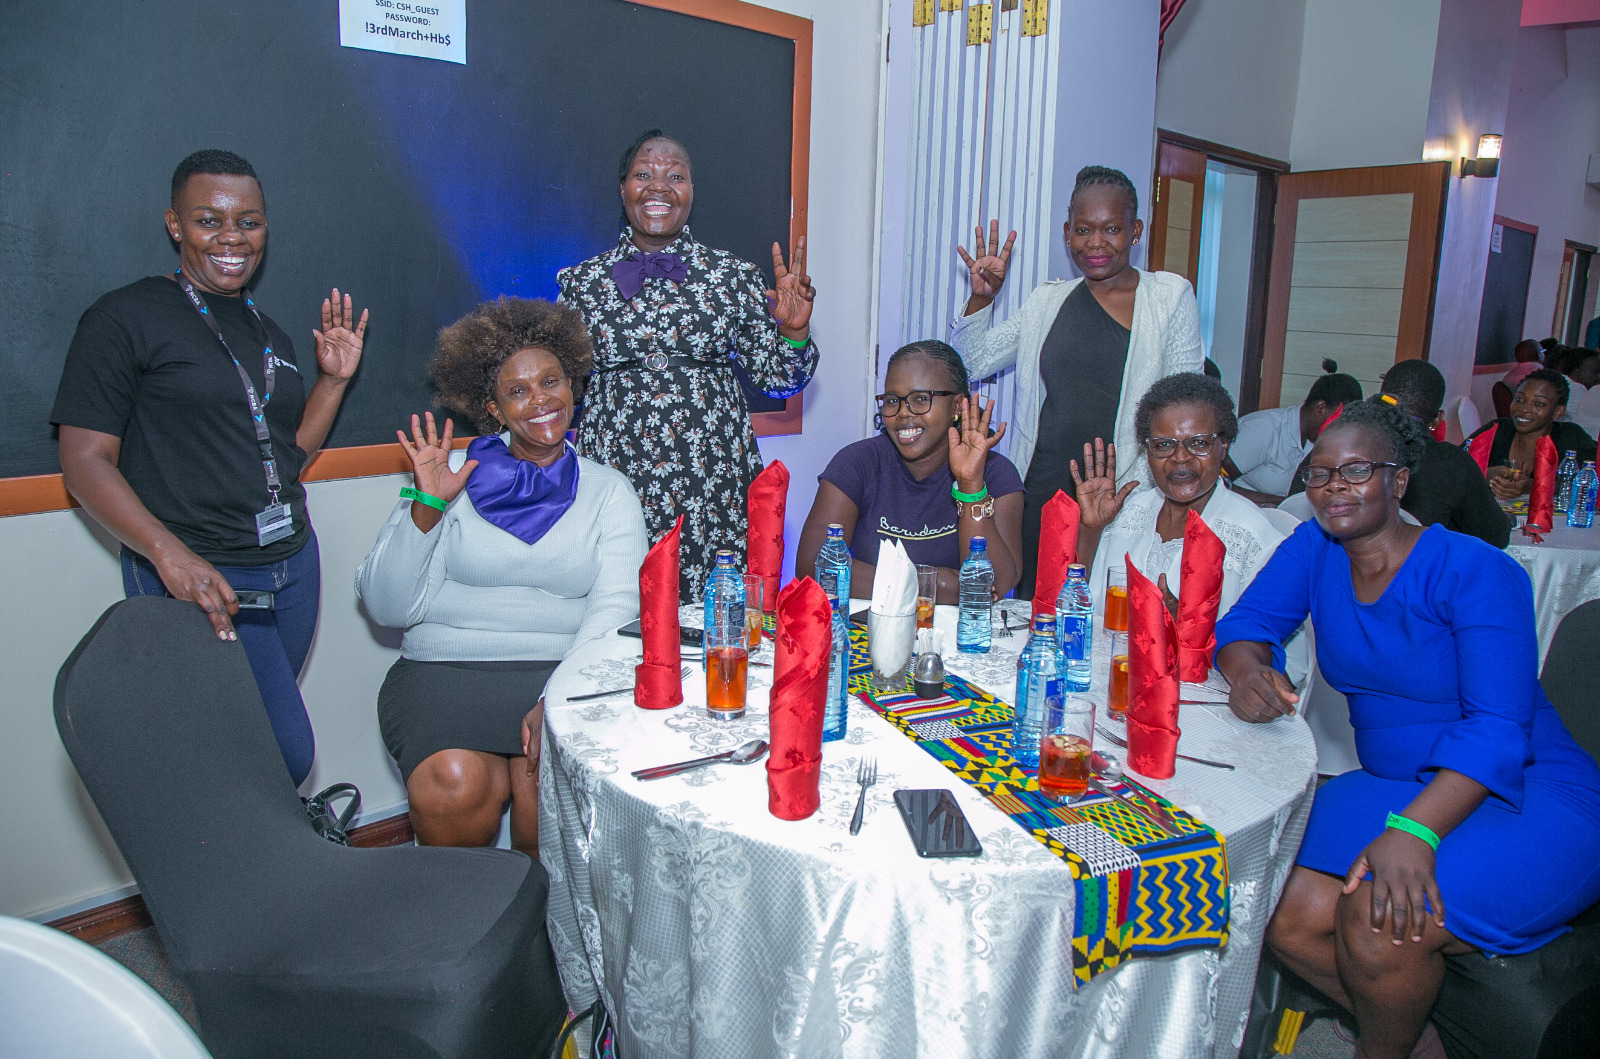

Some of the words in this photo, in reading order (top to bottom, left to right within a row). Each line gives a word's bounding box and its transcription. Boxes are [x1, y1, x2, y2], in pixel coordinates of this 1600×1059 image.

[376, 0, 394, 8] SSID:
[396, 3, 439, 16] CSH_GUEST
[386, 12, 430, 26] PASSWORD:
[366, 22, 451, 46] !3rdMarch+Hb$
[880, 516, 956, 536] Barudan
